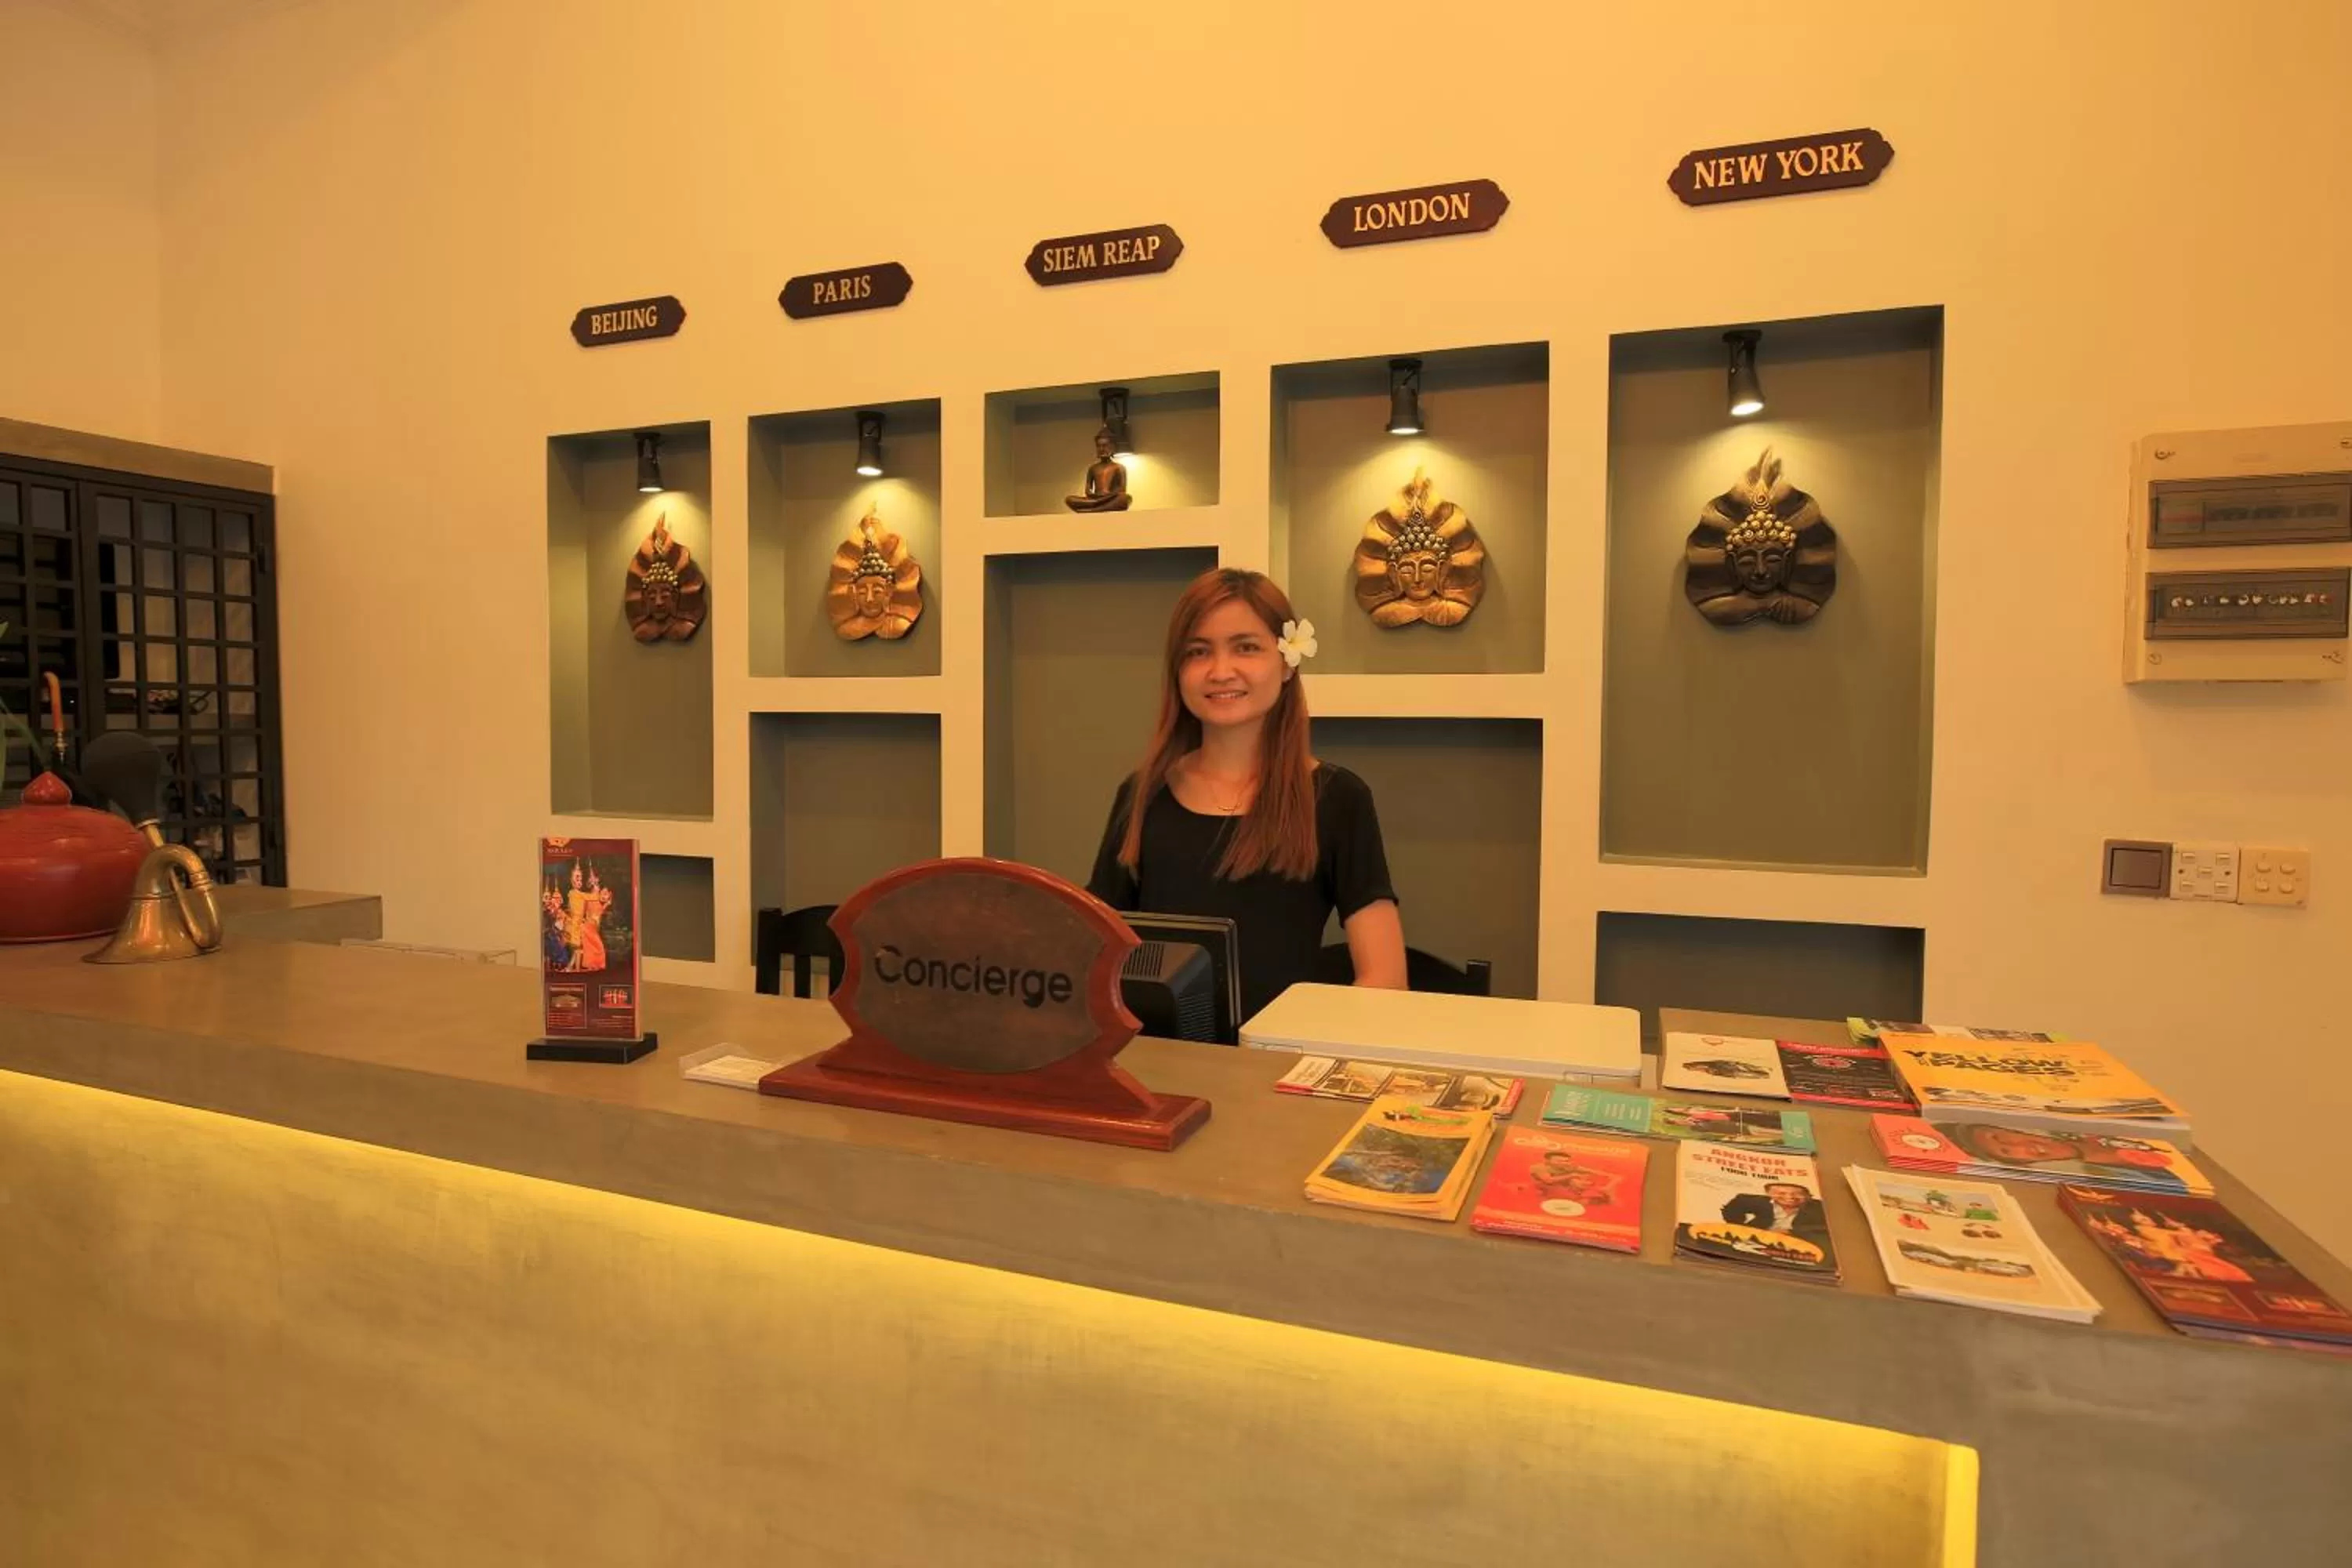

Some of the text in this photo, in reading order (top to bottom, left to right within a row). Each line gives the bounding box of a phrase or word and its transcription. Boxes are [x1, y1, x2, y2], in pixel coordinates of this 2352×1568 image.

[1693, 141, 1864, 190] NEW YORK
[1354, 193, 1471, 233] LONDON
[1043, 236, 1161, 273] SIEM REAP
[813, 274, 872, 304] PARIS
[590, 304, 658, 336] BEIJING
[874, 945, 1073, 1008] Concierge
[1903, 1049, 2064, 1067] YELLOW
[1929, 1060, 2077, 1076] PAGES
[1691, 1153, 1808, 1177] STREET EATS
[1711, 1149, 1787, 1167] ANGKOR
